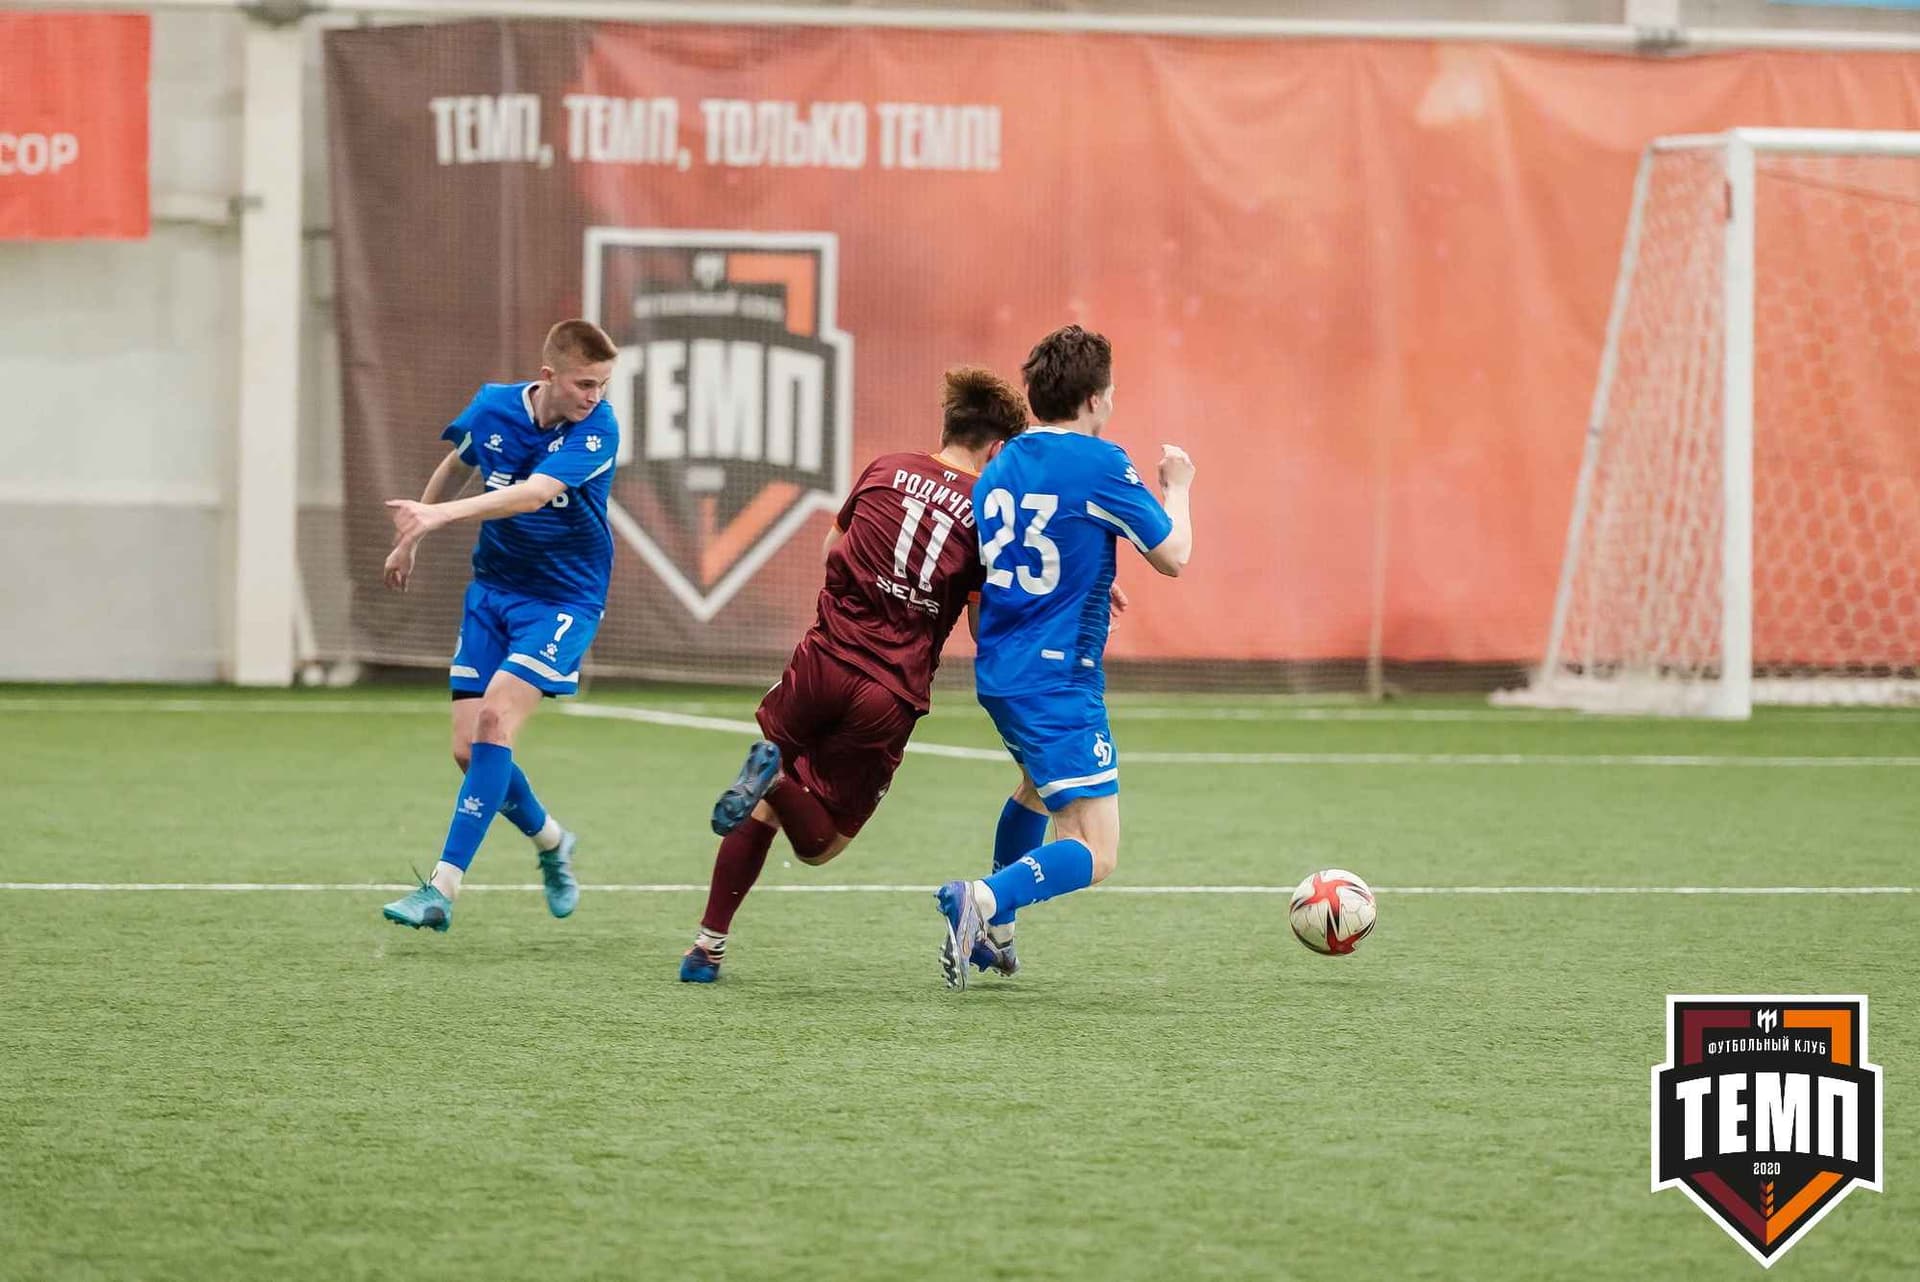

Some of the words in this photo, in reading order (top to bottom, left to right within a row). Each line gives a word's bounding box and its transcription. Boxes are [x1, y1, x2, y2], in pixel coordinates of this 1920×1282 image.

[430, 93, 553, 168] ТЕМП,
[564, 95, 691, 171] ТЕМП,
[701, 99, 867, 168] ТОЛЬКО
[876, 103, 1000, 170] ТЕМП!
[893, 496, 955, 593] 11
[979, 488, 1061, 595] 23
[553, 612, 574, 642] 7
